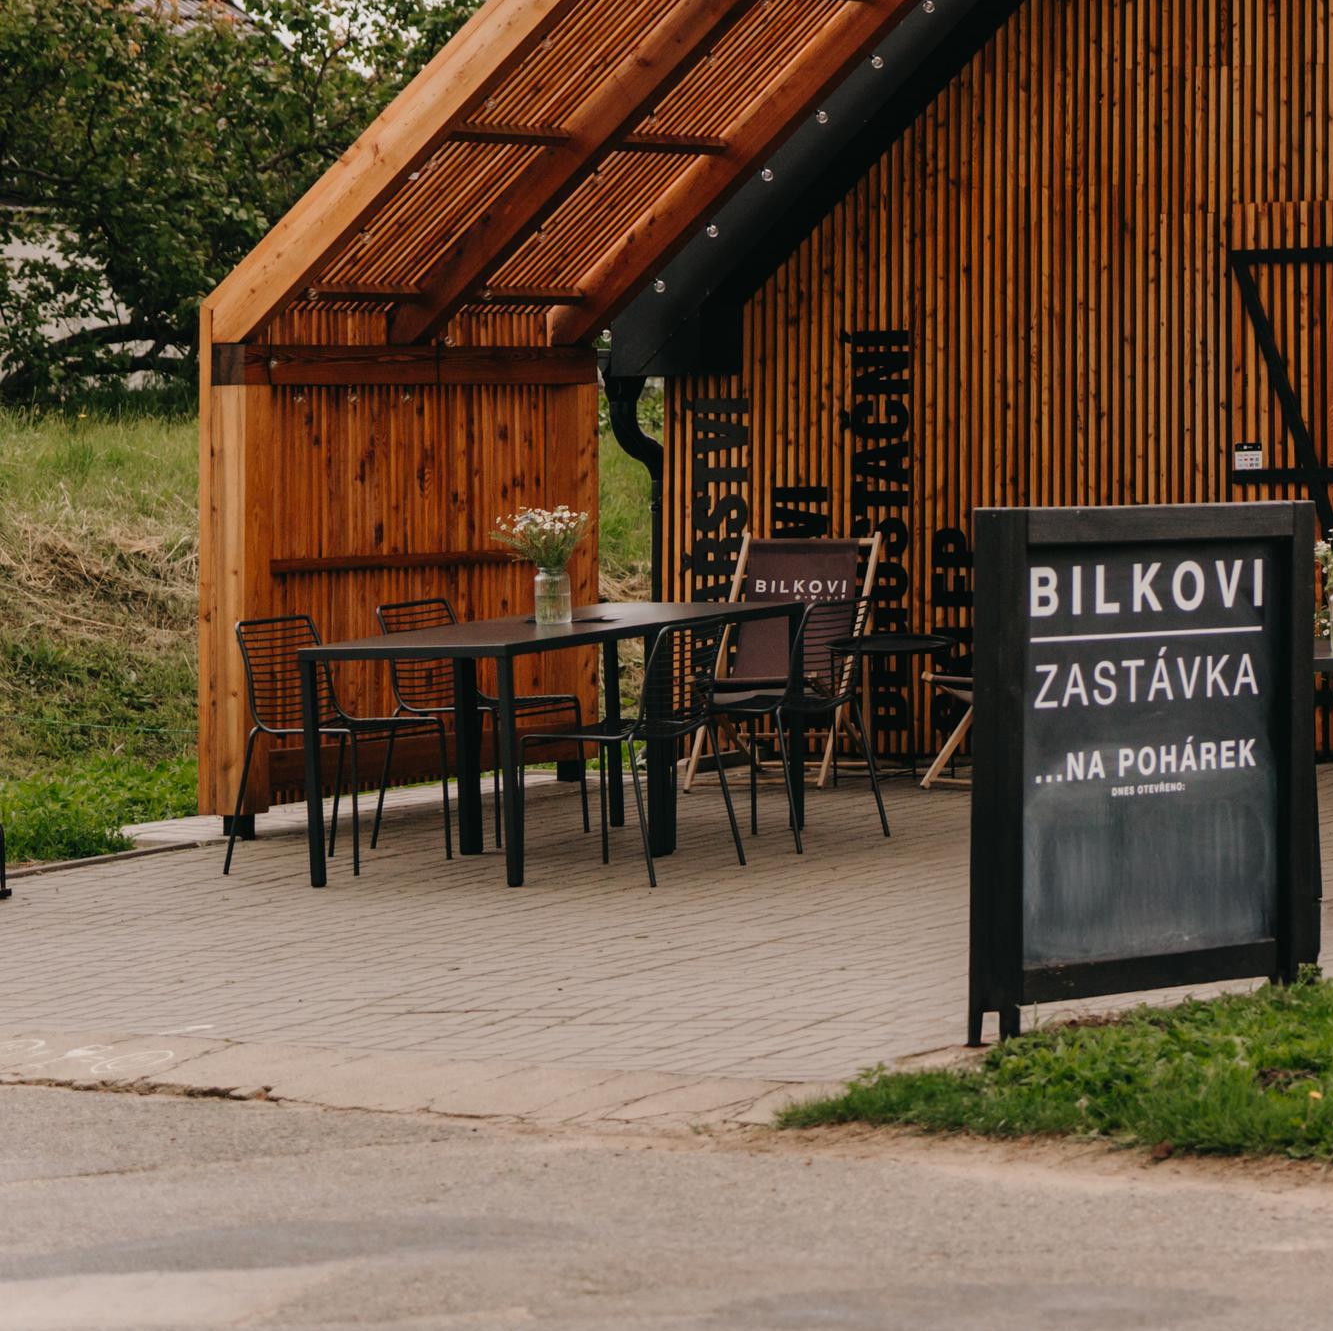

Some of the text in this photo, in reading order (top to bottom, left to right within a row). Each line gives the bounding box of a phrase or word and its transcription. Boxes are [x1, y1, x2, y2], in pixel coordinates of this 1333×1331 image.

[682, 397, 749, 603] ŘSTVÍ
[755, 579, 848, 594] BILKOVI
[1030, 559, 1264, 617] BILKOVI
[1034, 646, 1259, 709] ZASTÁVKA
[1118, 736, 1257, 777] POHÁREK
[1111, 781, 1186, 797] DNES OTEVŘENO:
